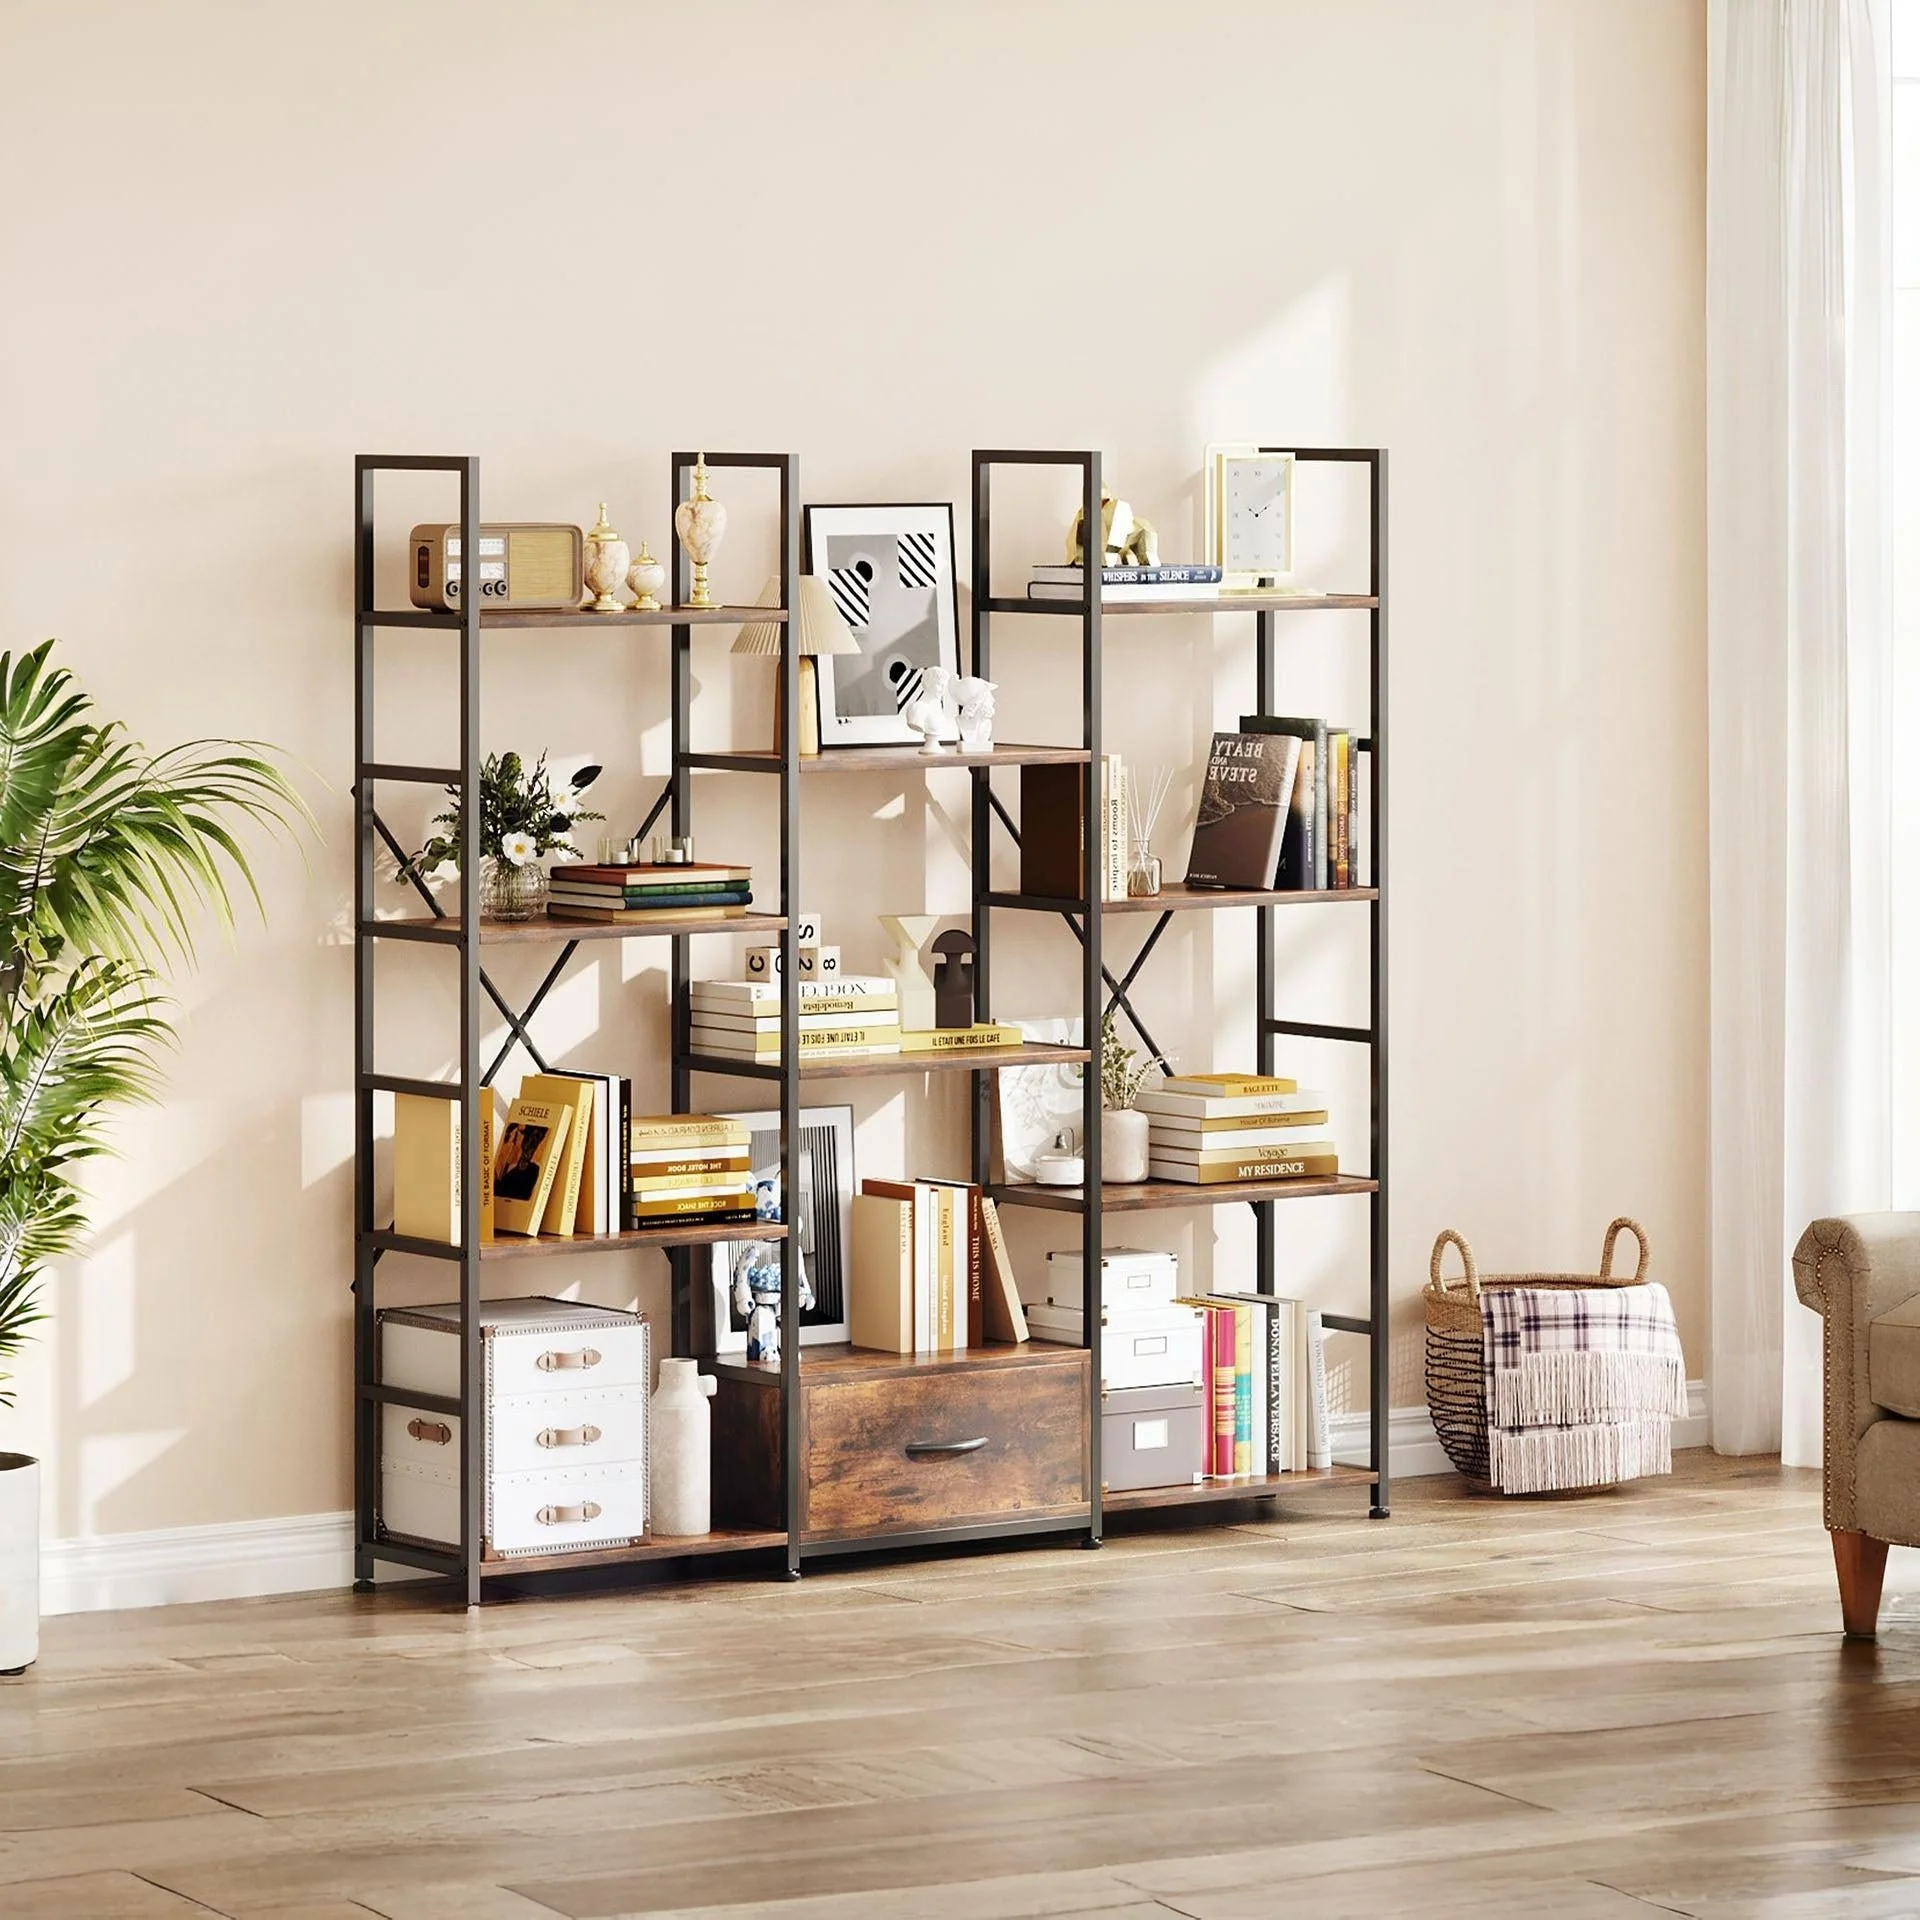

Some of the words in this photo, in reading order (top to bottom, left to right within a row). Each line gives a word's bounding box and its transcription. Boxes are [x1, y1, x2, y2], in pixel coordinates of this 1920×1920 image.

[1102, 570, 1138, 582] WHISPERS
[1140, 573, 1147, 581] IN
[1147, 573, 1158, 581] THE
[1159, 570, 1190, 581] SILENCE
[799, 924, 814, 939] S
[750, 955, 765, 972] C
[799, 957, 813, 971] 2
[823, 957, 836, 970] 8
[803, 1001, 853, 1012] Remodelista
[802, 1034, 810, 1045] LE
[810, 1033, 826, 1044] FOIS
[826, 1033, 840, 1044] UNE
[954, 1035, 965, 1046] UNE
[966, 1035, 979, 1045] FOIS
[979, 1033, 986, 1044] LE
[1243, 1084, 1280, 1094] BAGUETTE
[518, 1105, 550, 1120] SCHIELE
[1258, 1147, 1288, 1160] Voyage
[484, 1155, 491, 1166] OF
[1238, 1166, 1254, 1178] MY
[1254, 1162, 1305, 1176] RESIDENCE
[972, 1236, 980, 1259] THIS
[972, 1260, 980, 1270] IS
[972, 1272, 980, 1301] HOME
[1270, 1318, 1280, 1399] DONATELLA
[1270, 1400, 1280, 1462] VERSACE
